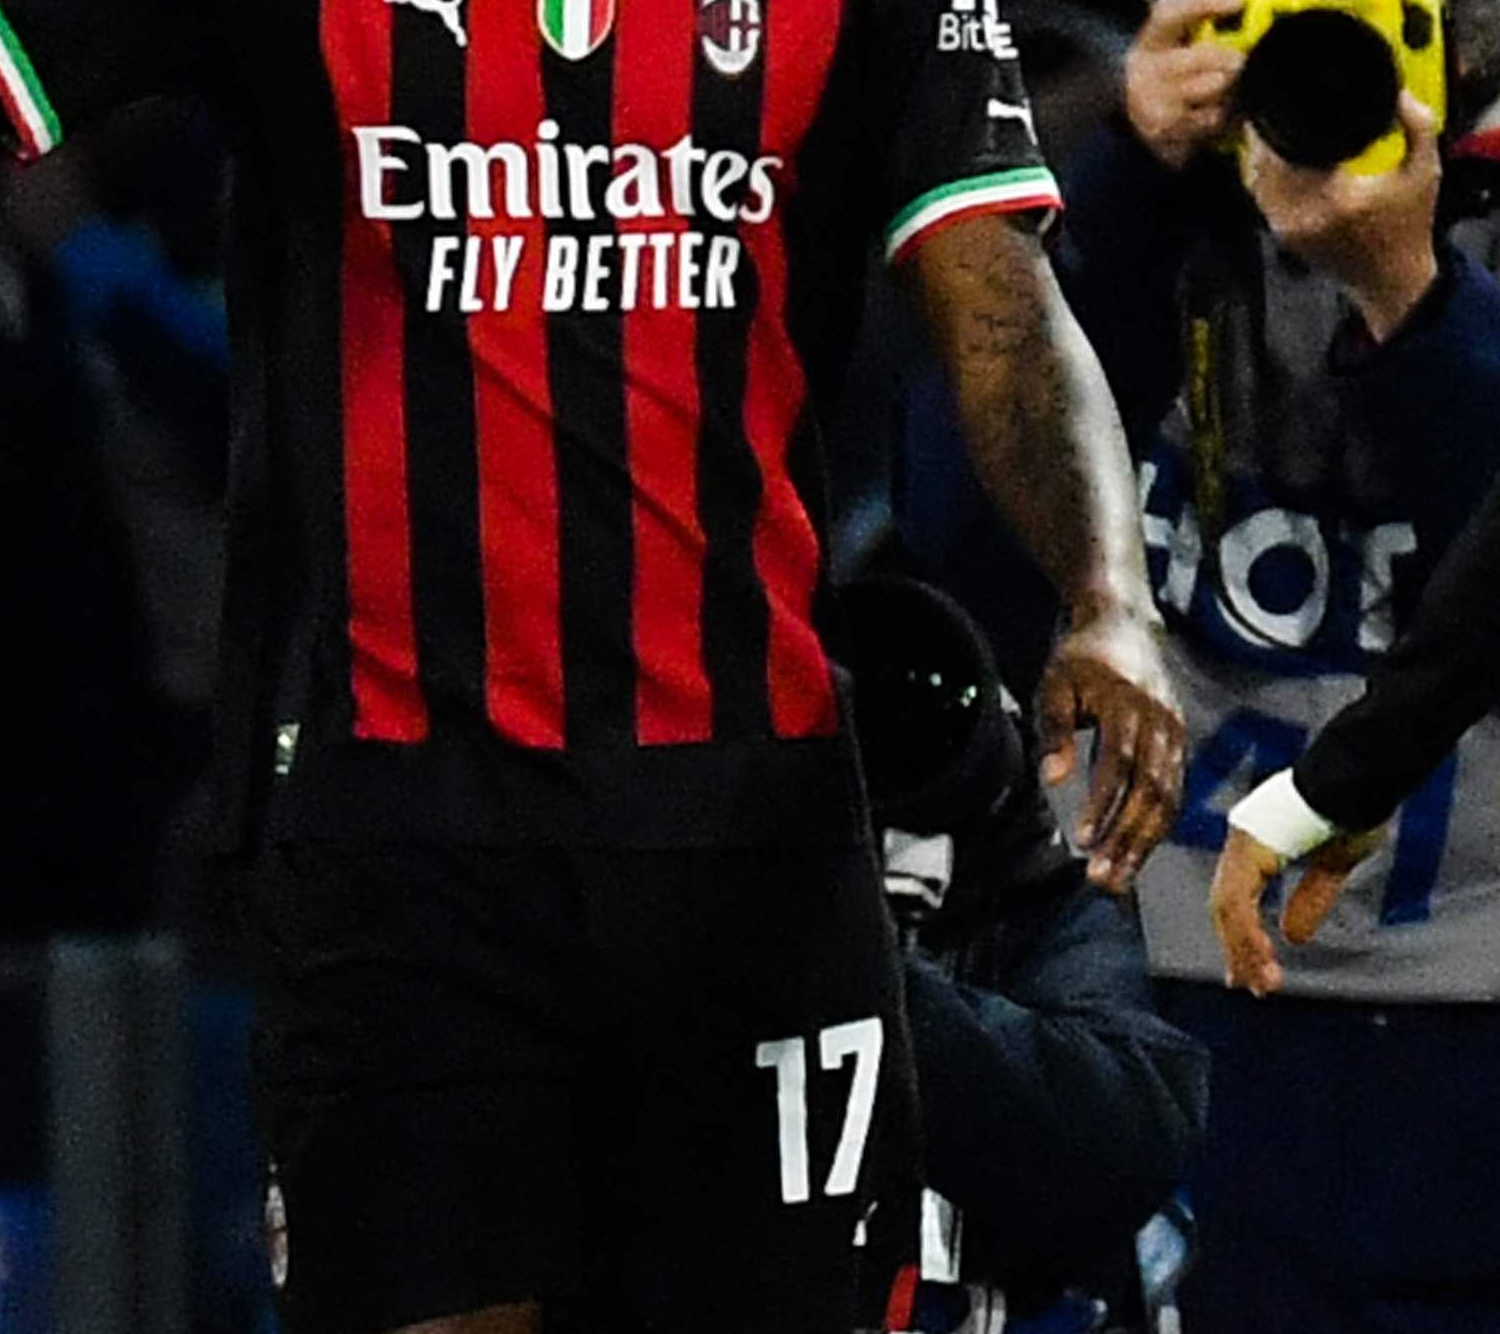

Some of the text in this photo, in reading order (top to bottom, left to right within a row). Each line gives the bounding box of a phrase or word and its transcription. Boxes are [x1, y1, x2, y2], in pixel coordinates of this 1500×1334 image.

[351, 118, 785, 224] Emirates
[425, 231, 741, 313] FLY BETTER
[754, 1015, 885, 1206] 17
